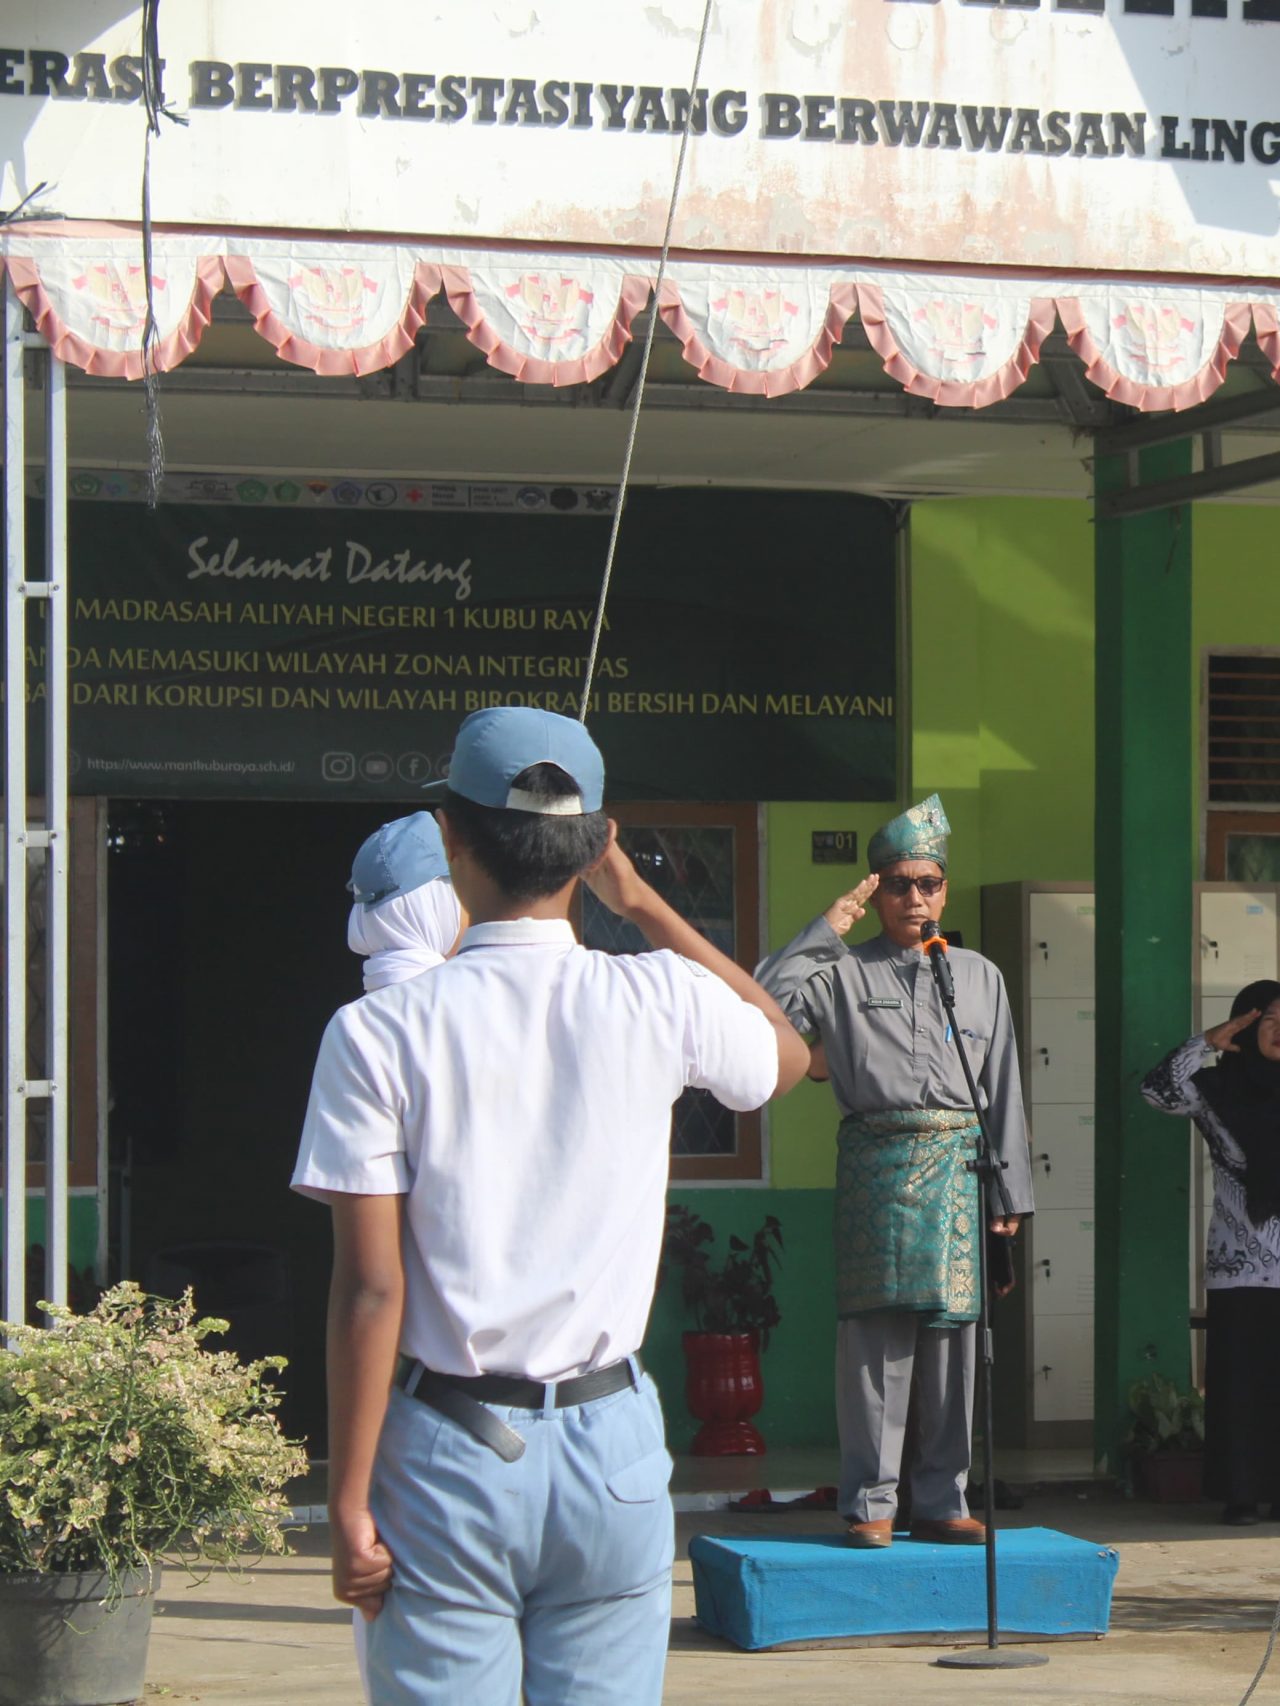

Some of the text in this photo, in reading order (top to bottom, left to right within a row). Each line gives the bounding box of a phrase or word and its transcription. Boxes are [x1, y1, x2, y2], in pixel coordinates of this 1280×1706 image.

[760, 93, 1147, 158] BERWAWASAN
[187, 536, 472, 601] Selamat Datang
[74, 598, 232, 623] MADRASAH
[239, 602, 334, 625] ALIYAH
[341, 604, 436, 628] NEGERI
[443, 607, 456, 628] 1
[463, 608, 537, 630] KUBU
[543, 609, 611, 632] RAYA
[108, 648, 260, 673] MEMASUKI
[266, 651, 387, 675] WILAYAH
[394, 654, 473, 676] ZONA
[73, 683, 137, 706] DARI
[146, 684, 263, 707] KORUPSI
[271, 686, 329, 709] DAN
[337, 688, 457, 711] WILAYAH
[608, 692, 695, 714] BERSIH
[702, 694, 757, 715] DAN
[766, 694, 893, 717] MELAYANI
